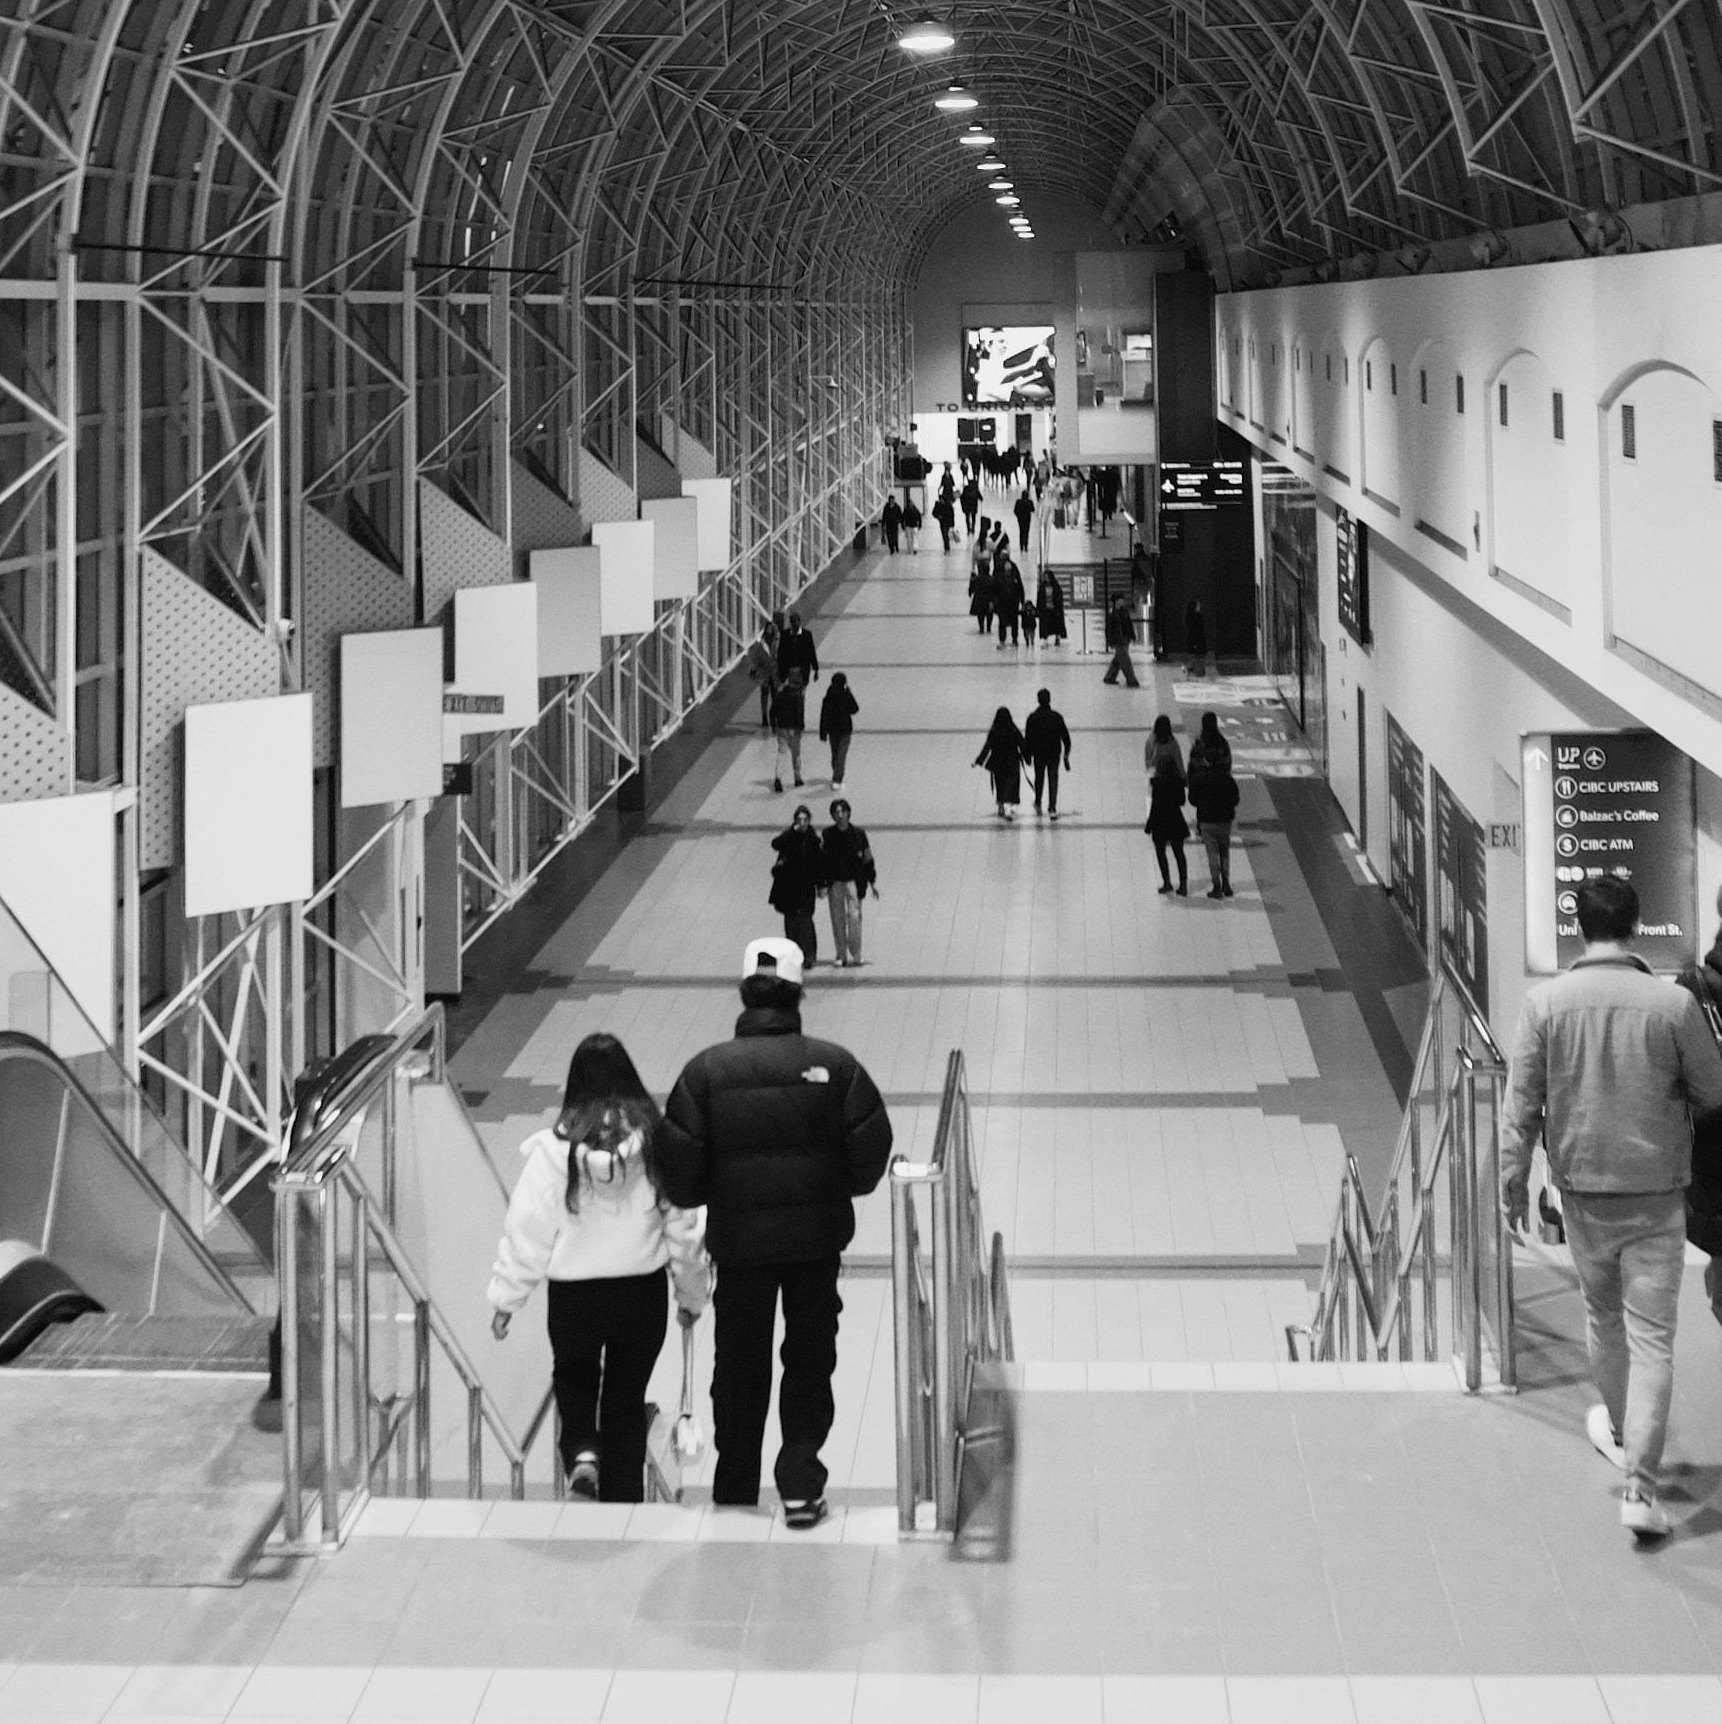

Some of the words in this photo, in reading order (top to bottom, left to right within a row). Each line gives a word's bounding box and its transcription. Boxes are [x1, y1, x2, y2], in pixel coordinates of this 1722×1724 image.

[936, 403, 959, 412] TO
[968, 403, 1025, 412] UNION
[1557, 746, 1581, 763] UP
[1579, 781, 1607, 793] CIBC
[1608, 780, 1660, 793] UPSTAIRS
[1579, 810, 1622, 822] Balzac's
[1623, 810, 1660, 822] Coffee
[1491, 825, 1521, 847] EXI
[1580, 839, 1608, 851] CIBC
[1609, 839, 1634, 851] ATM
[1638, 924, 1667, 936] Front
[1668, 923, 1683, 936] St.
